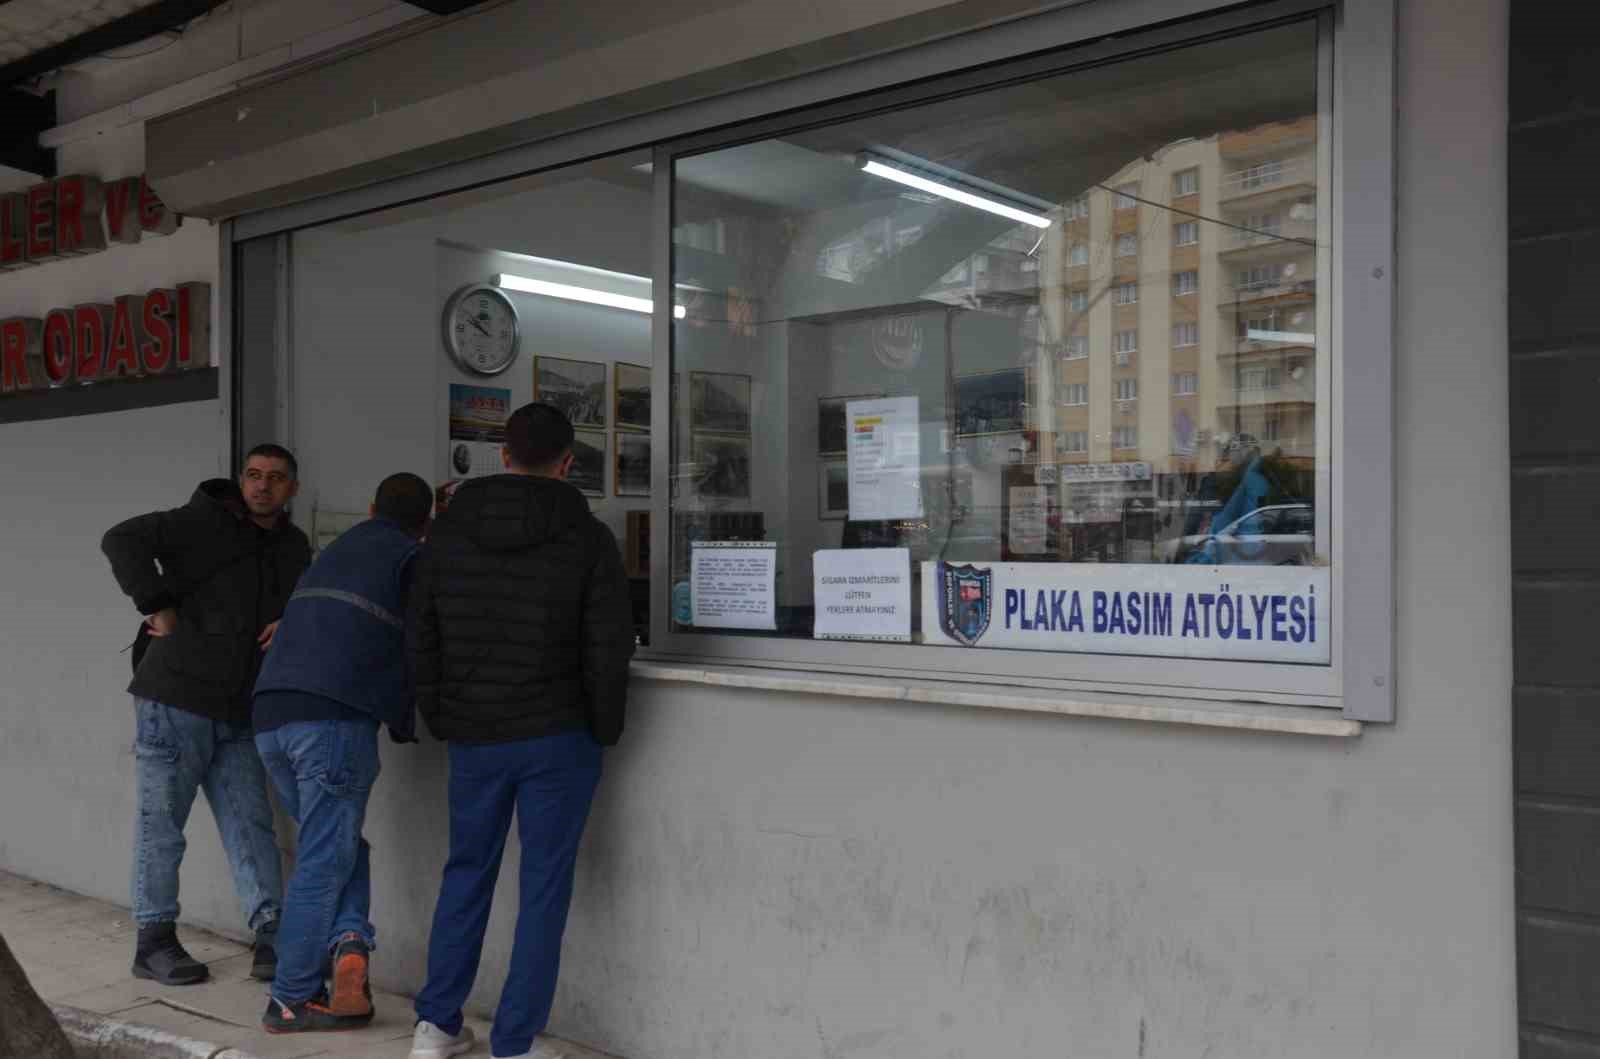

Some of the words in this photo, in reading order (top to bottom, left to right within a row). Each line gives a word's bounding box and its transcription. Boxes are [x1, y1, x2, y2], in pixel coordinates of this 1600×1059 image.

[42, 285, 193, 385] ODASI
[1004, 588, 1084, 633] PLAKA
[1092, 590, 1173, 638] BASIM
[1181, 583, 1317, 643] ATÖLYESİ
